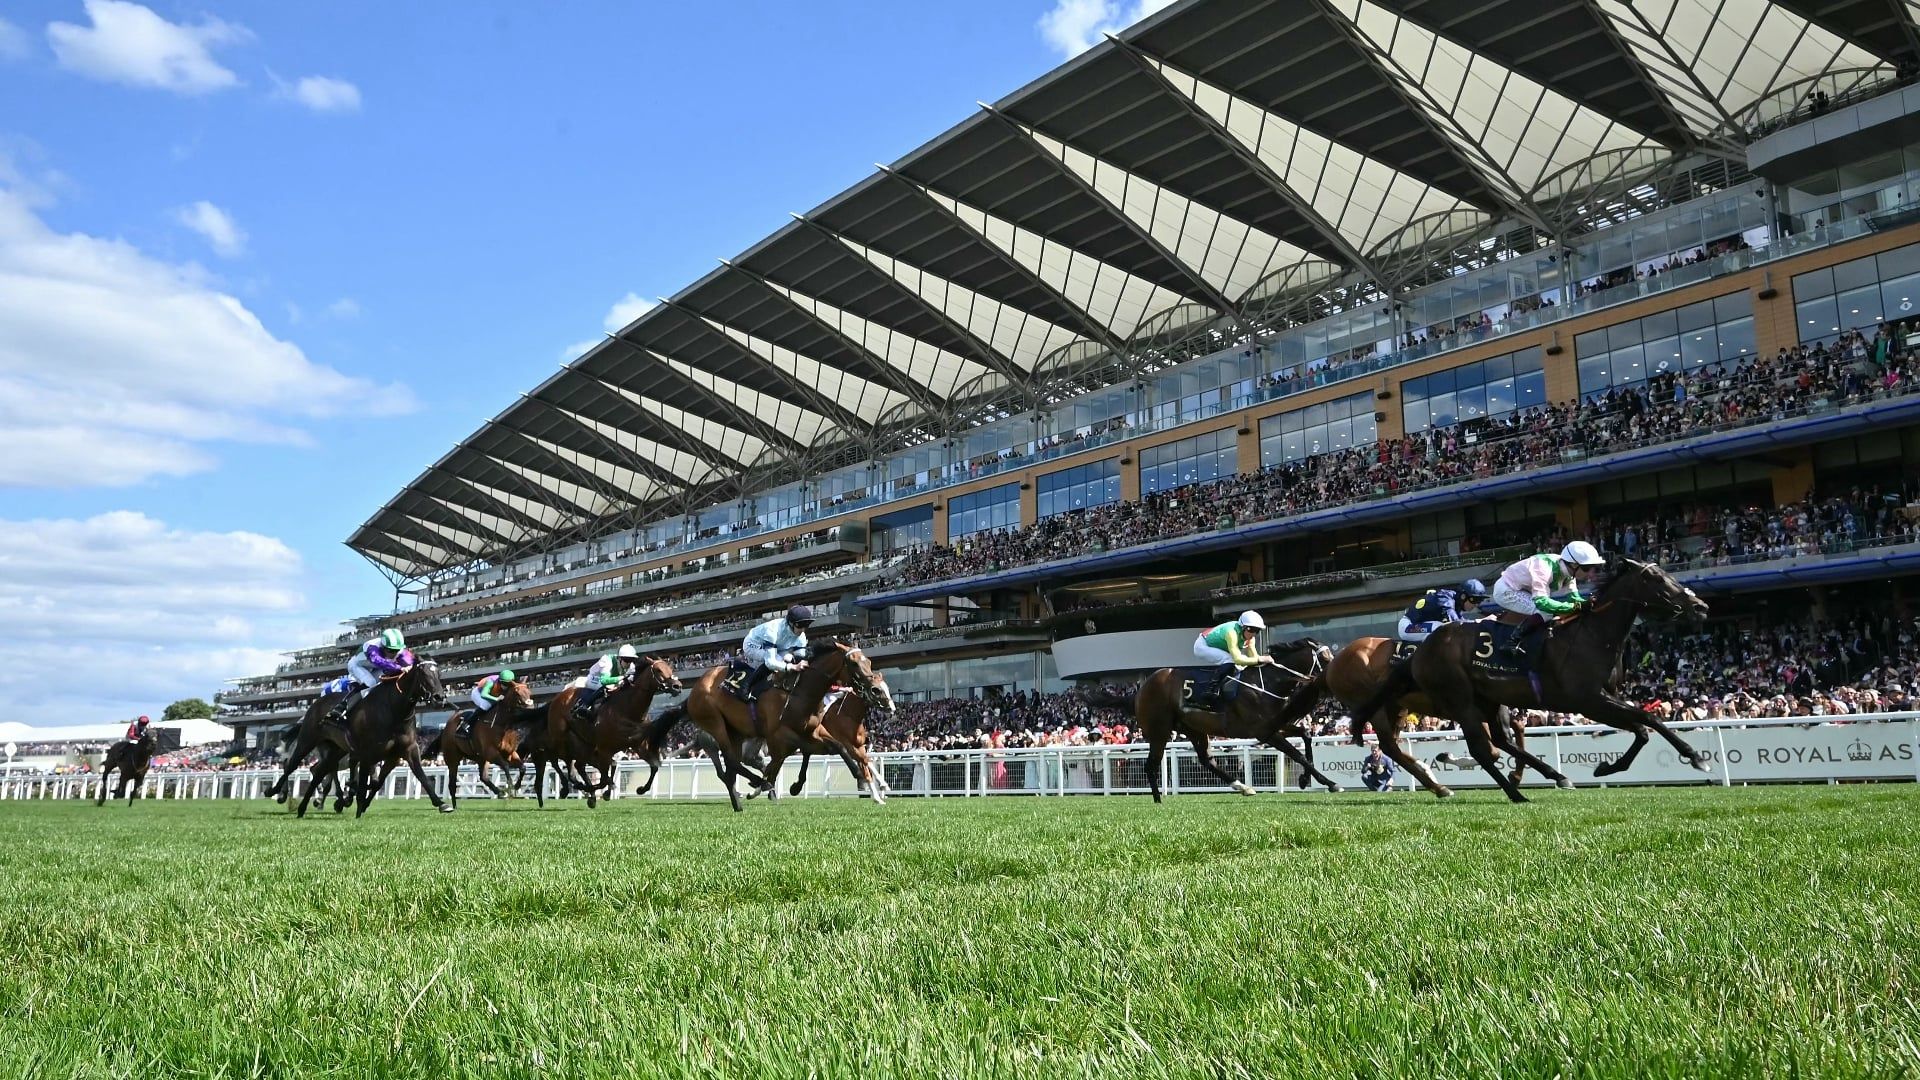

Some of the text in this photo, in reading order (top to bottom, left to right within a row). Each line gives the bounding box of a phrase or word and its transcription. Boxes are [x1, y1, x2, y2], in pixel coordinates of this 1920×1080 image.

[1474, 631, 1495, 659] 3
[1183, 679, 1196, 700] 5
[1559, 751, 1625, 764] LONGINE
[1758, 746, 1842, 764] ROYAL
[1878, 743, 1920, 761] AS
[1321, 760, 1366, 772] LONGIN
